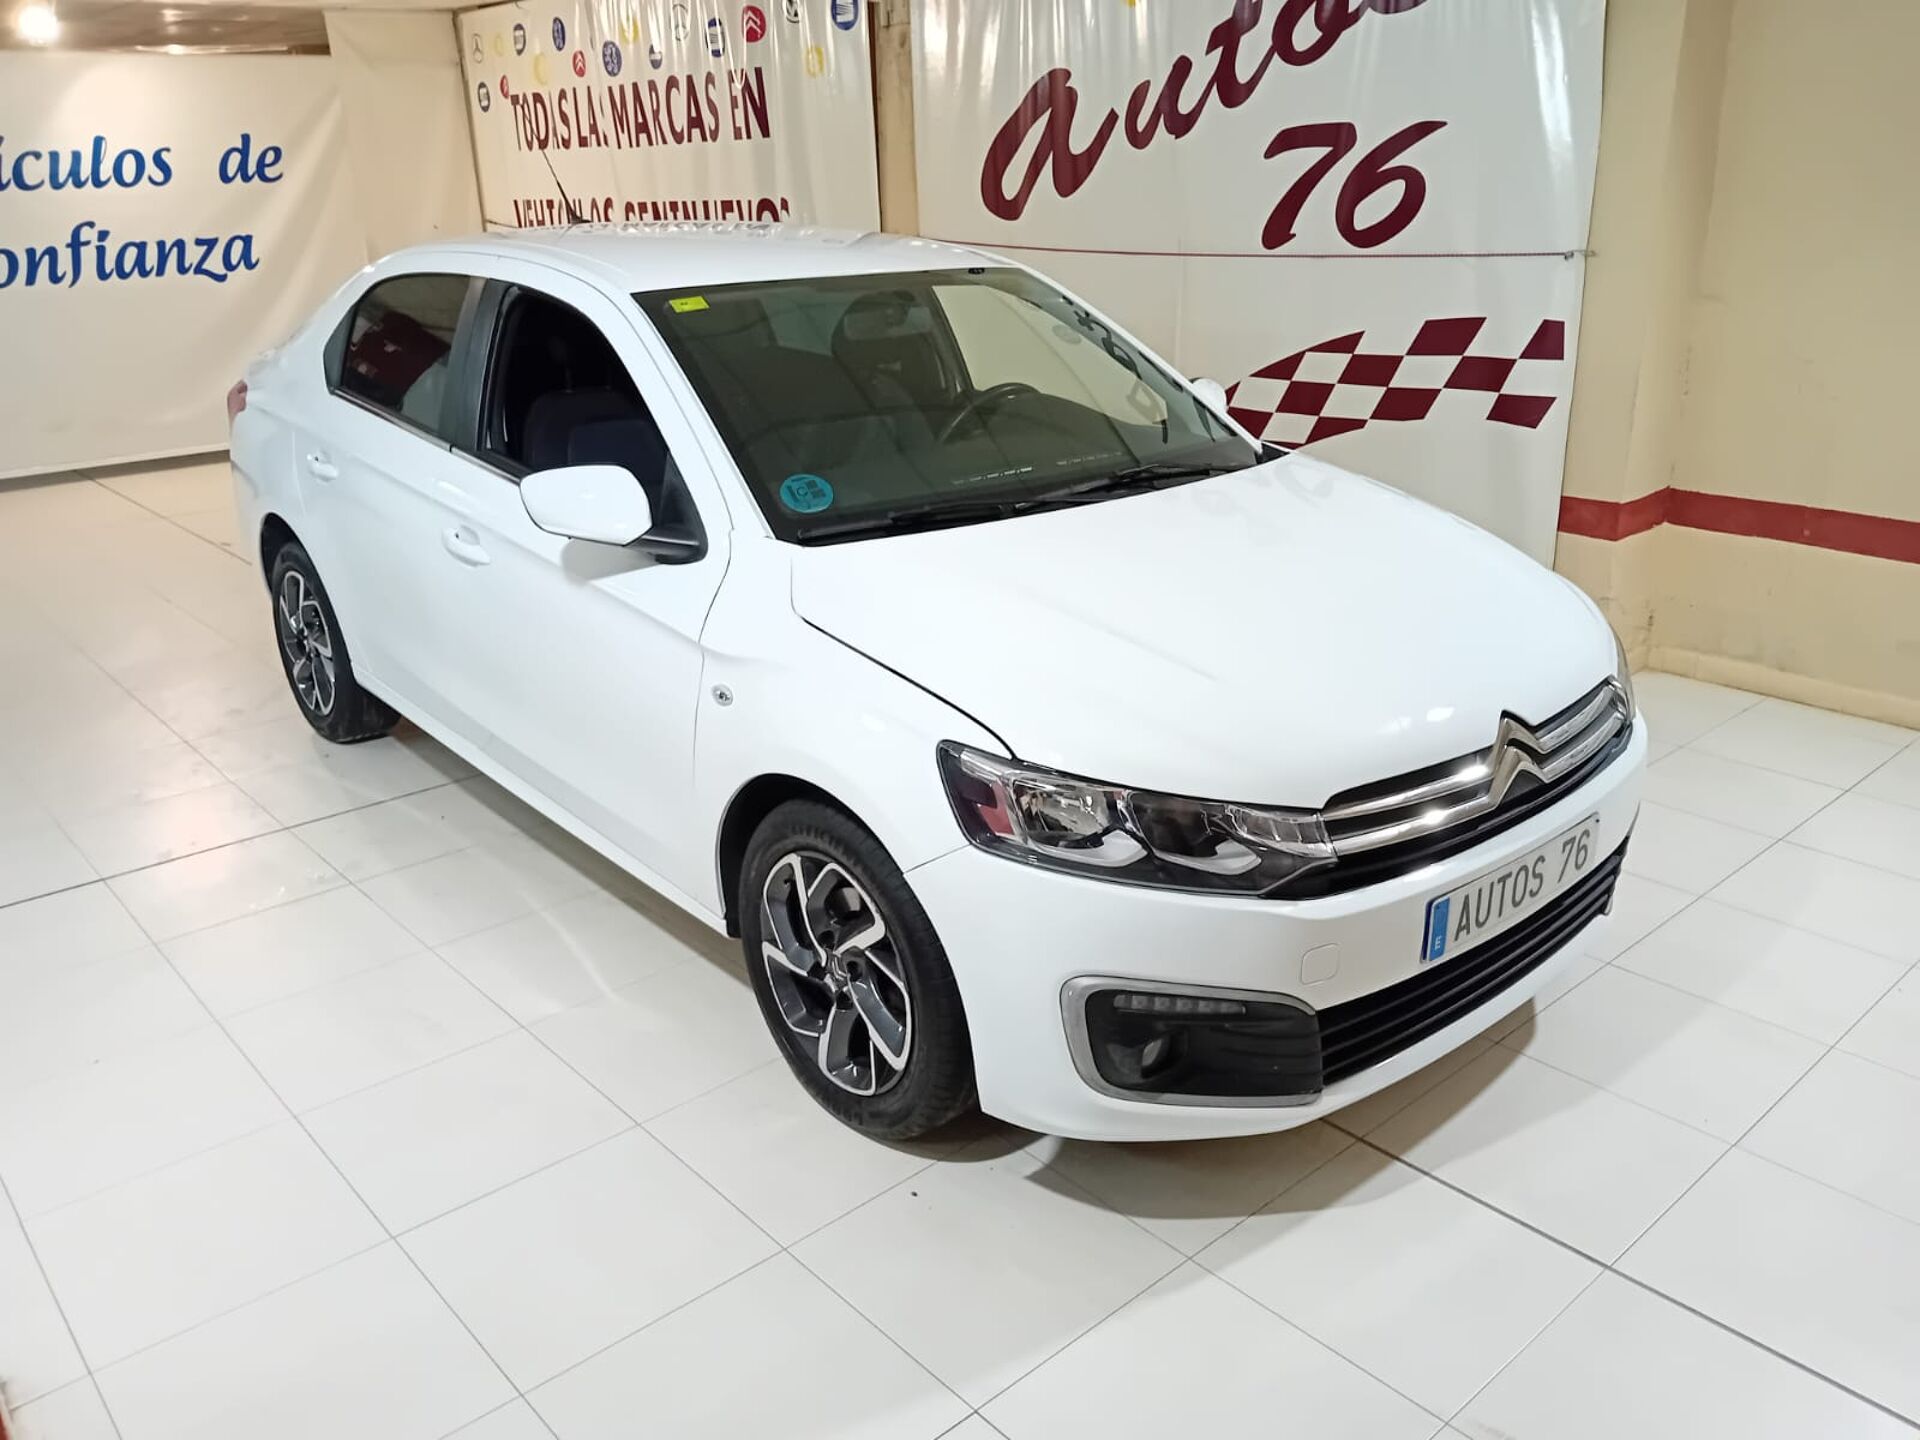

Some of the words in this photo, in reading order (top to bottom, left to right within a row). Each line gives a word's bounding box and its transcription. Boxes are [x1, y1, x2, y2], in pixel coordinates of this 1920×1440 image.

[218, 133, 284, 185] de
[608, 71, 720, 149] MARCAS
[727, 67, 770, 140] EN
[981, 0, 1428, 221] Auto
[1261, 120, 1448, 250] 76
[1454, 855, 1546, 942] AUTOS
[1557, 829, 1591, 883] 76
